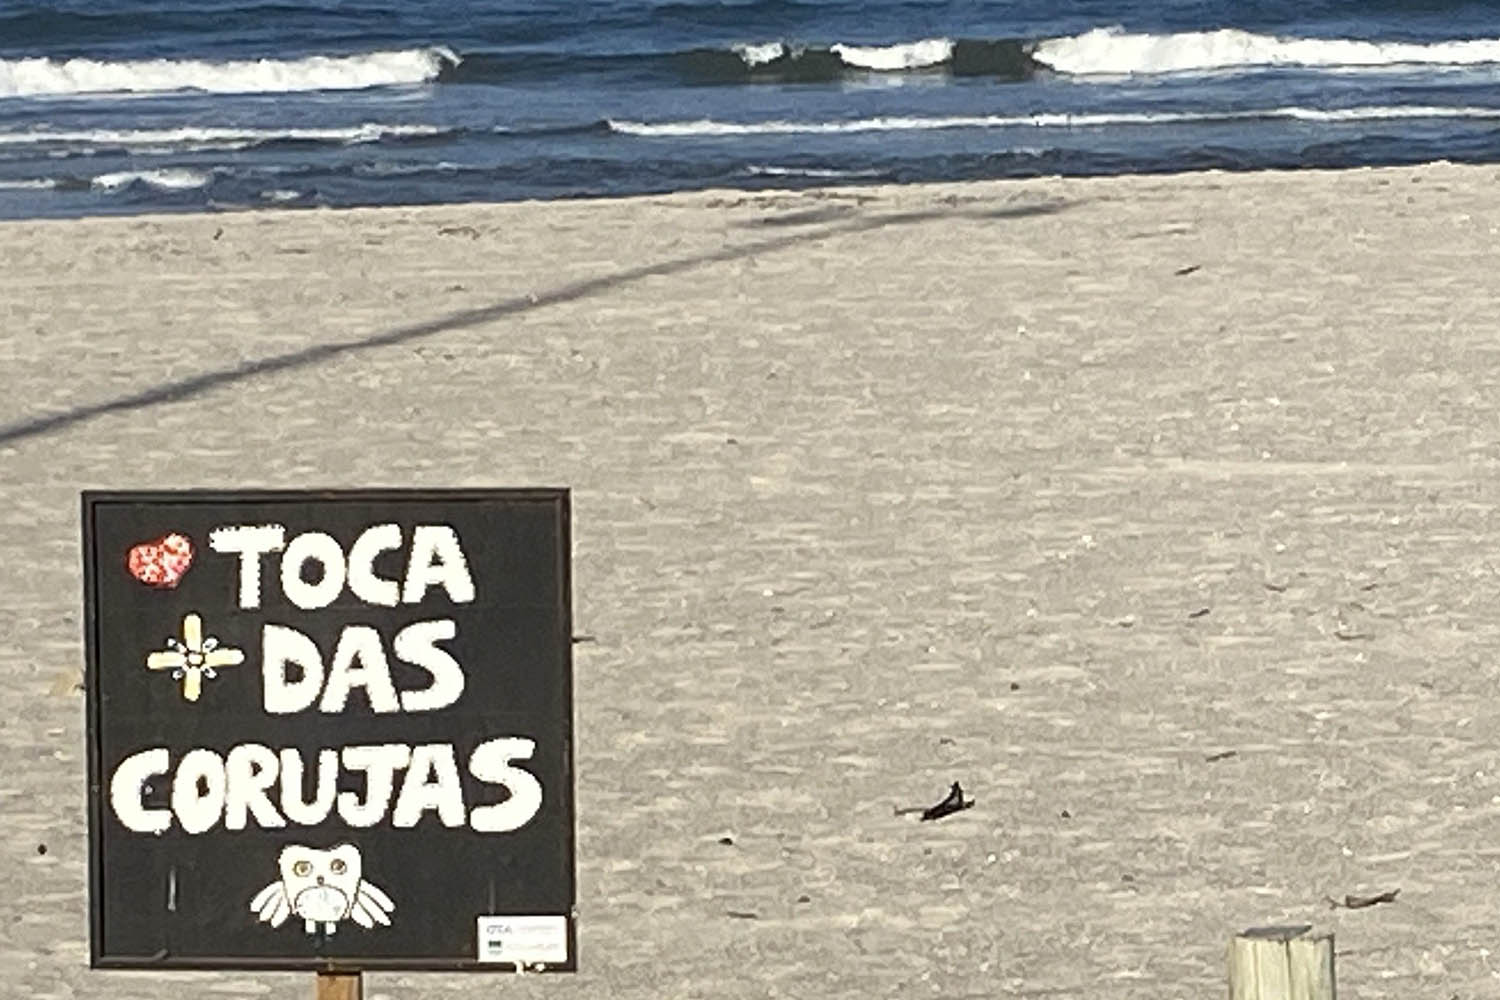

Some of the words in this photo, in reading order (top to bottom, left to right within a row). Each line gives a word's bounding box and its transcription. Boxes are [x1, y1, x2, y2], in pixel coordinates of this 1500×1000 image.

[209, 523, 475, 610] TOCA
[263, 619, 465, 714] DAS
[110, 736, 544, 835] CORUJAS
